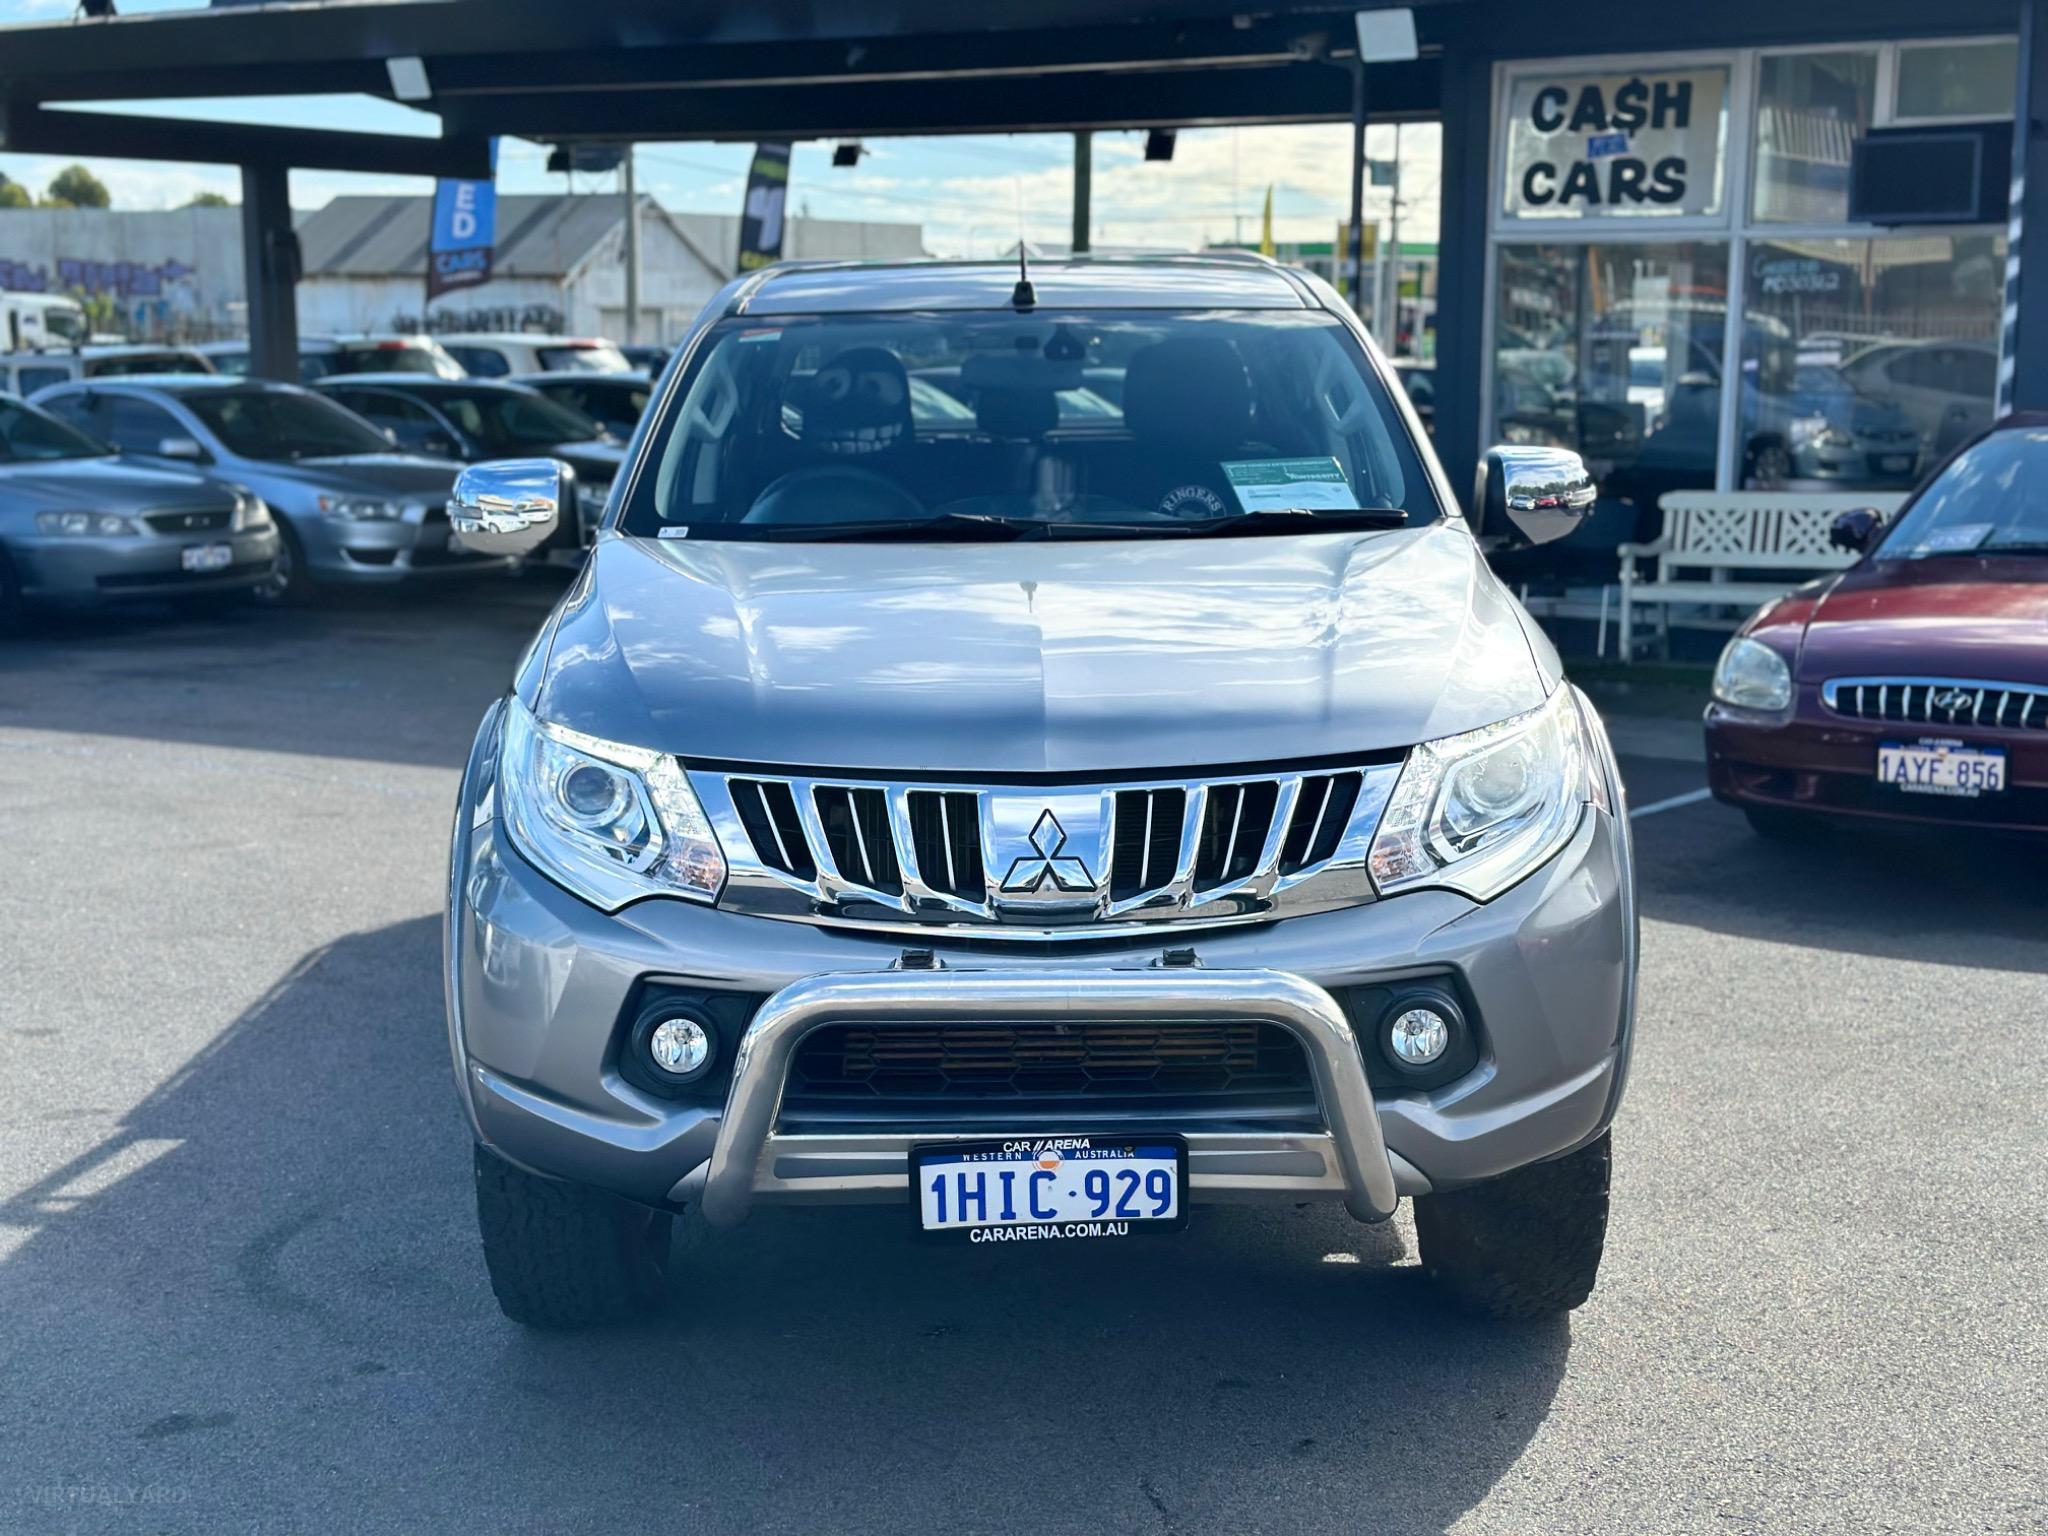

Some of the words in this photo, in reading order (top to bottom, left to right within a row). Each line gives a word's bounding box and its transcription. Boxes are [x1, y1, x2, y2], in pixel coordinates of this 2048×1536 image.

[1522, 156, 1687, 205] CARS
[1163, 487, 1221, 511] RINGERS
[962, 1151, 1022, 1161] WESTERN
[1074, 1149, 1135, 1159] AUSTRALIA
[969, 1221, 1129, 1243] CARARENA.COM.AU
